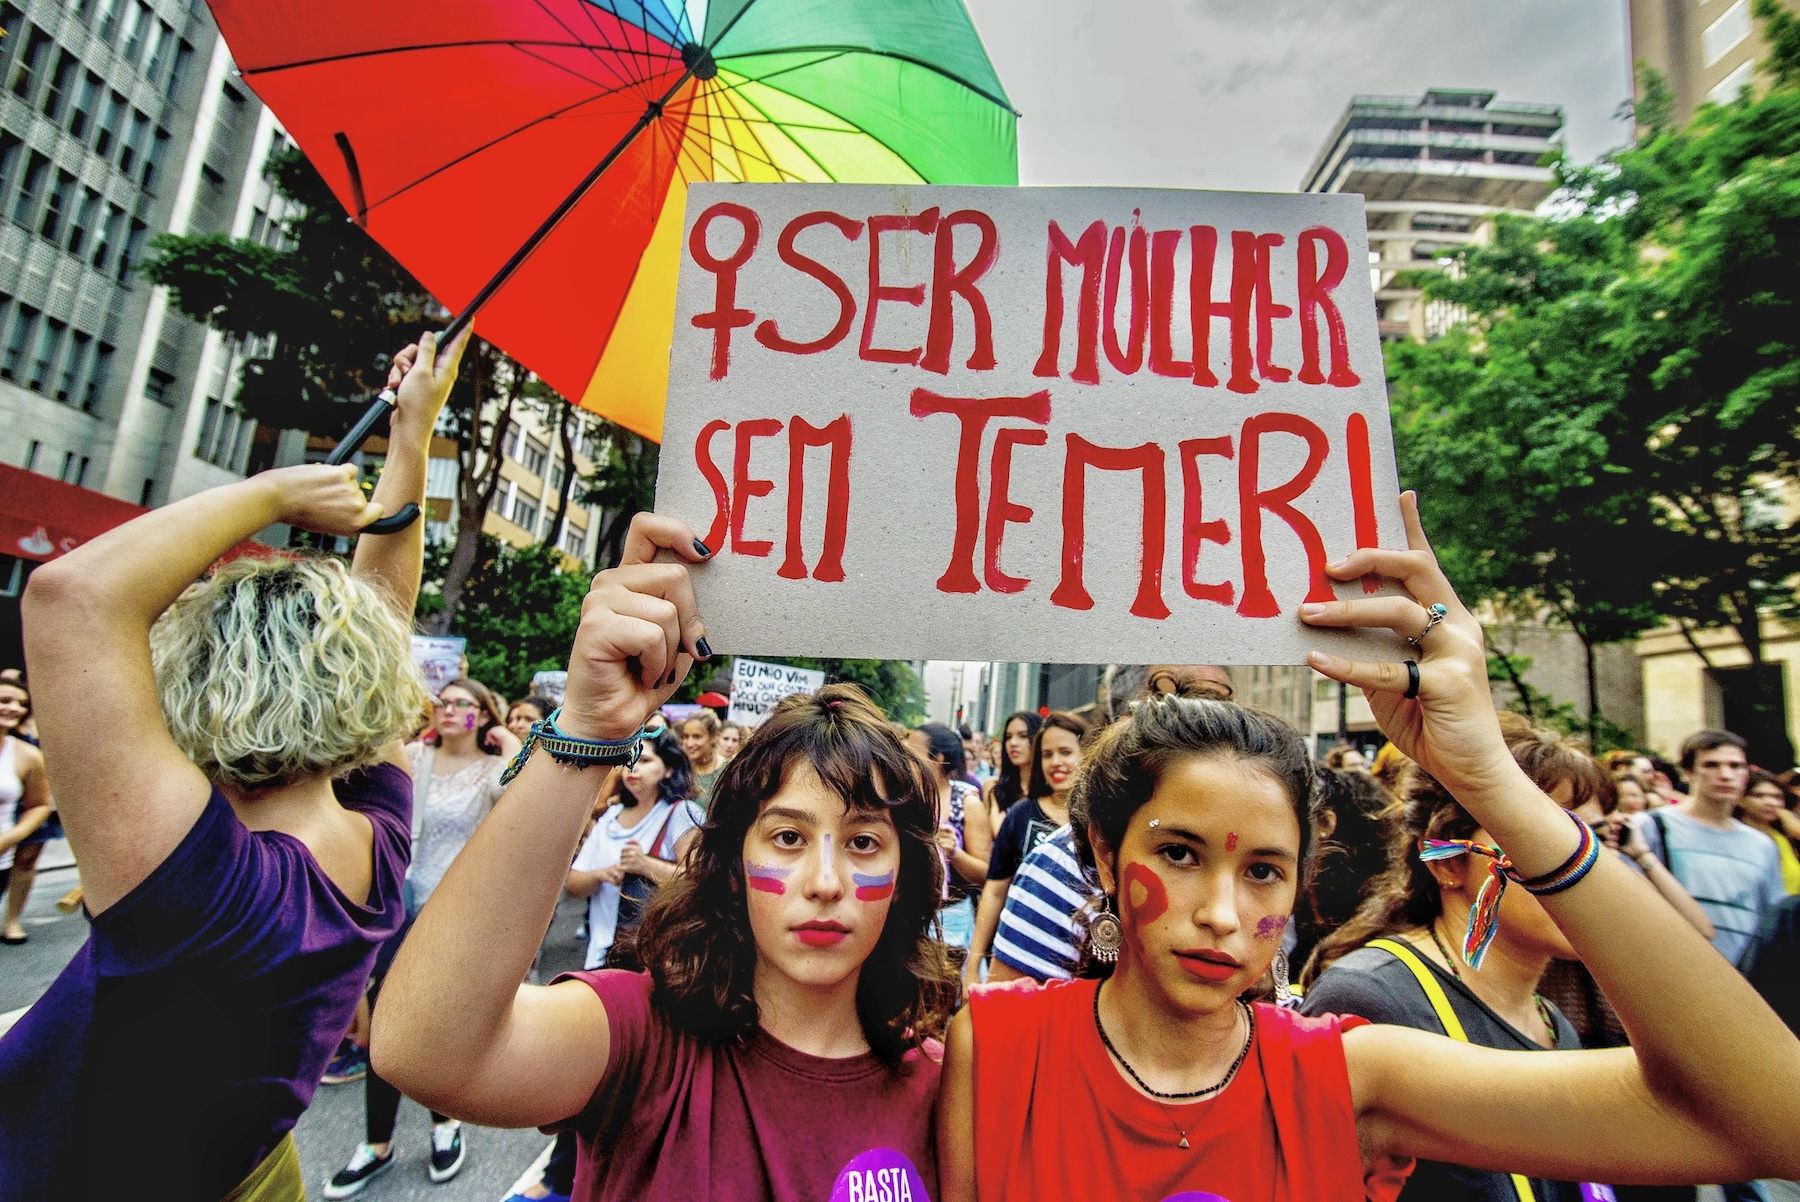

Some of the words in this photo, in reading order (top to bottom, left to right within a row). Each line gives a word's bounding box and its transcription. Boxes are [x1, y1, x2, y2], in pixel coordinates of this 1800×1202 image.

[755, 206, 1000, 376] SER
[694, 412, 853, 583] SEM
[739, 662, 756, 677] EU
[847, 1167, 913, 1202] BASTA
